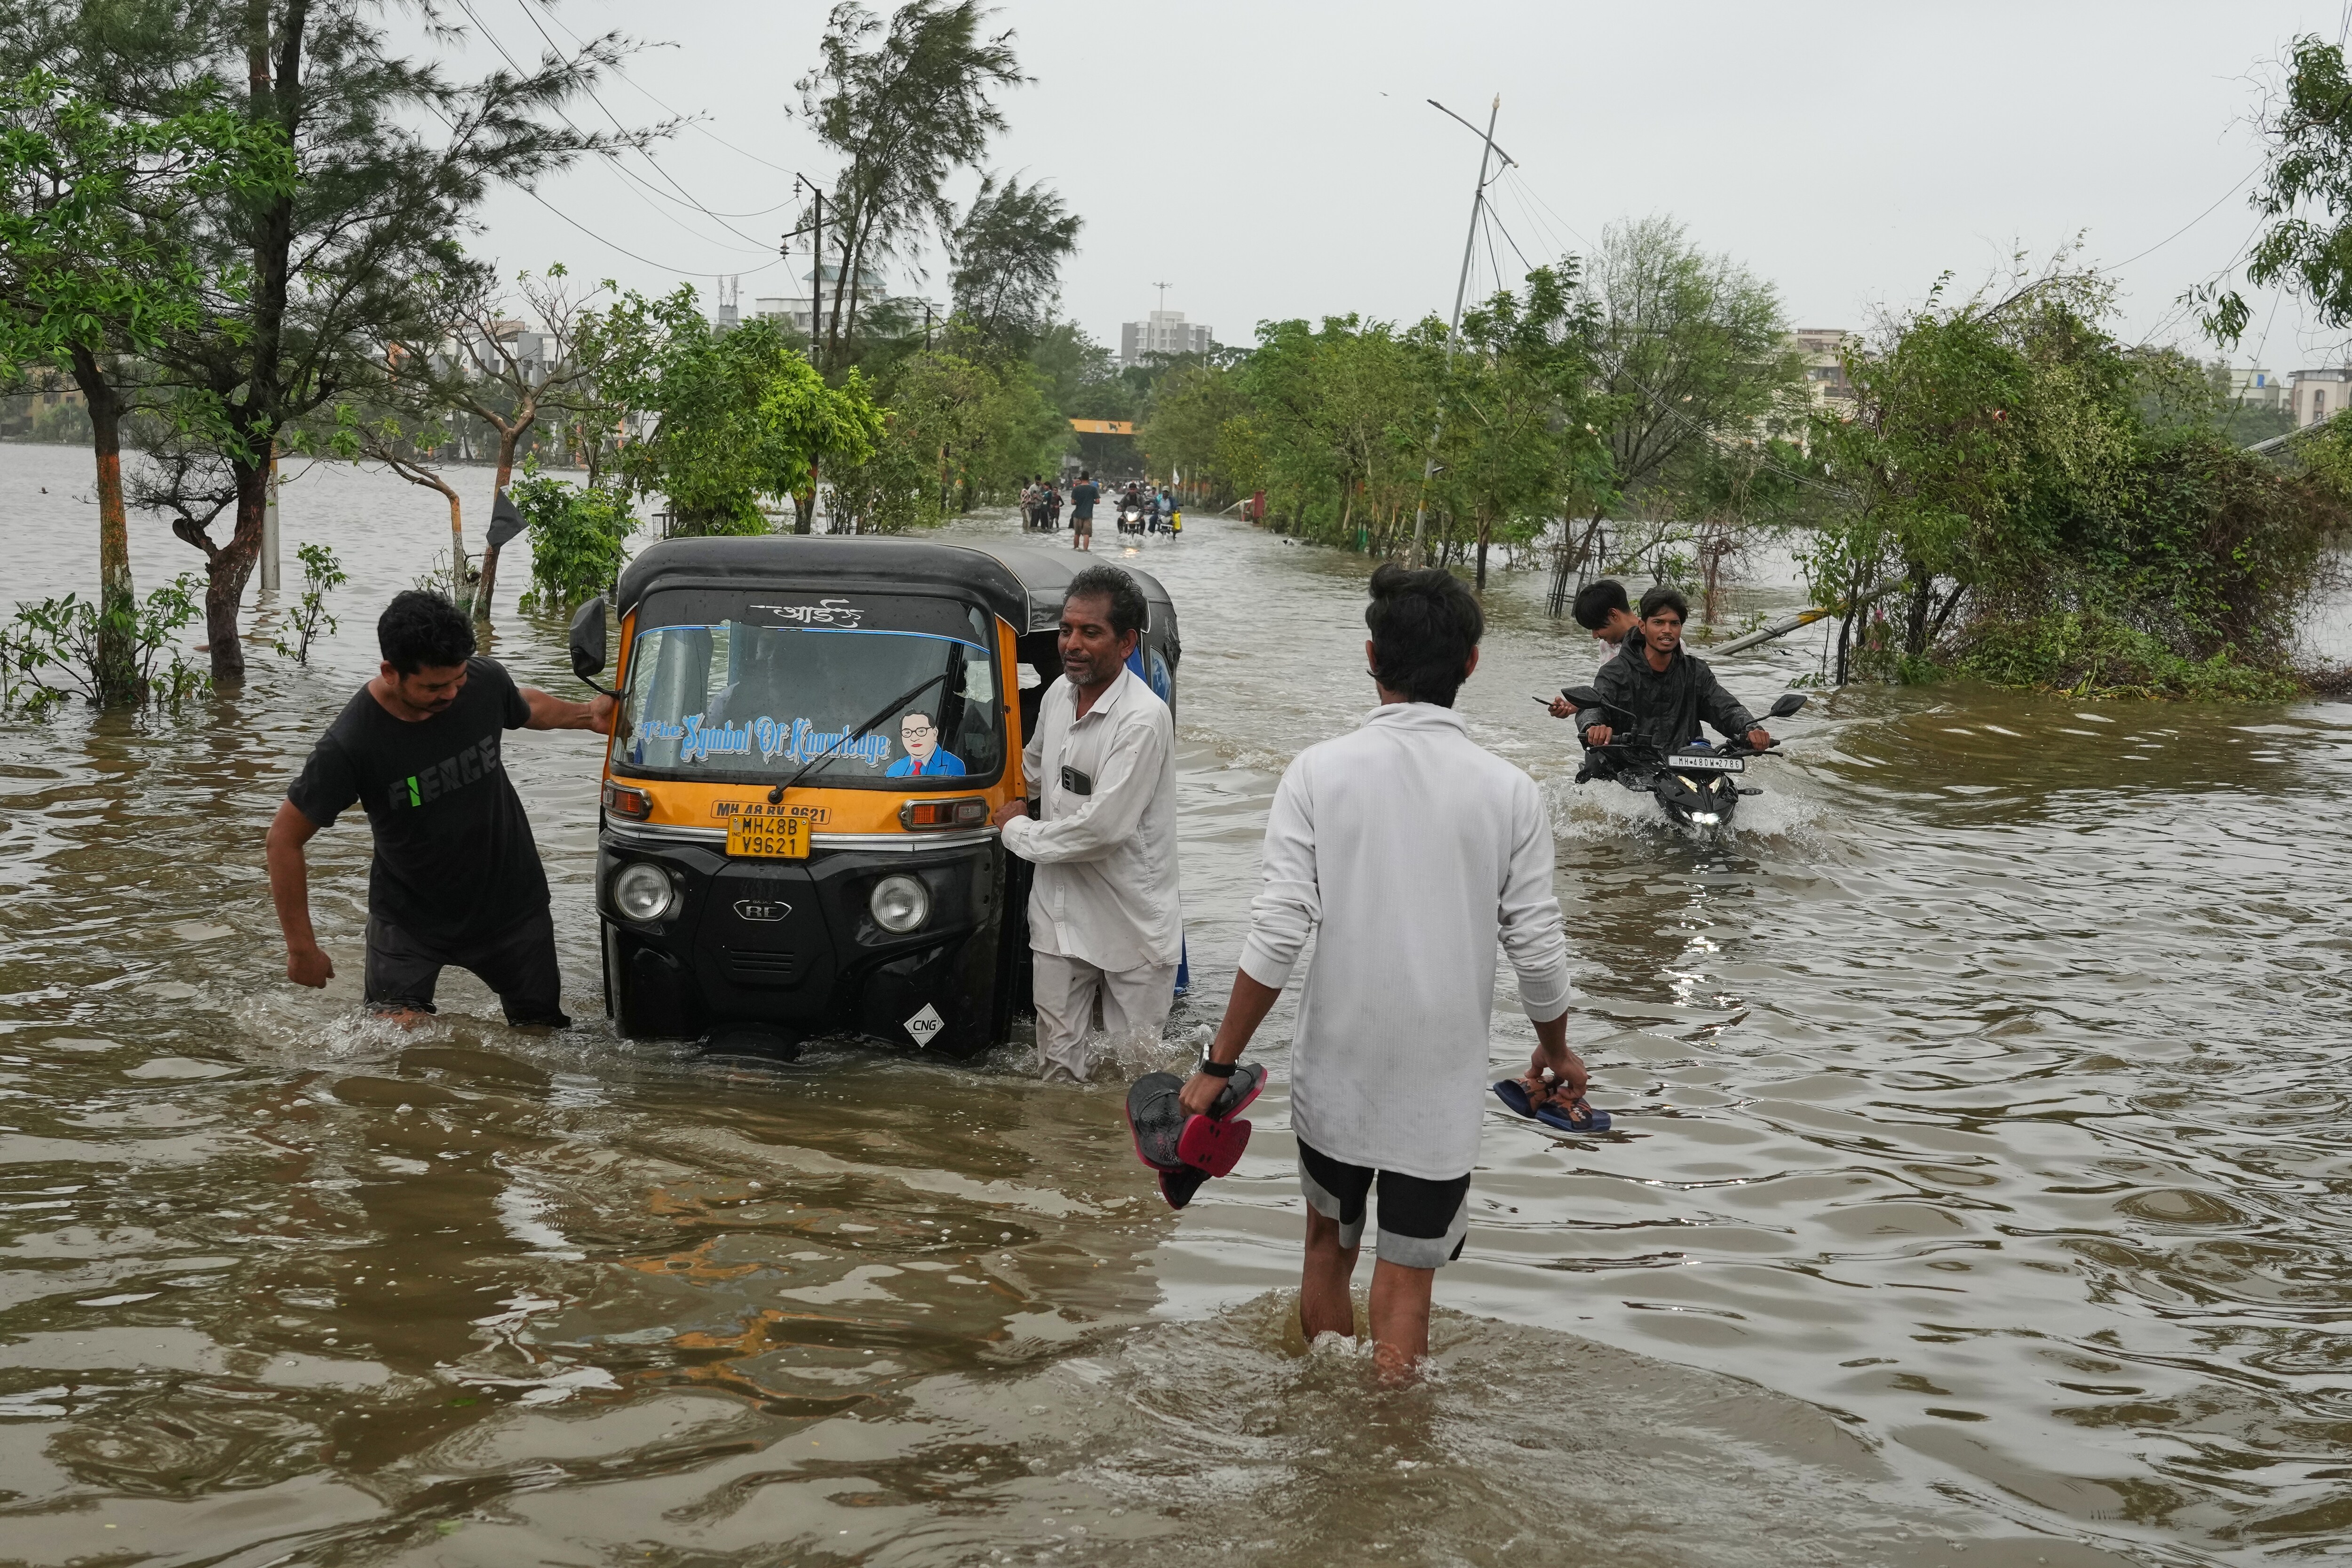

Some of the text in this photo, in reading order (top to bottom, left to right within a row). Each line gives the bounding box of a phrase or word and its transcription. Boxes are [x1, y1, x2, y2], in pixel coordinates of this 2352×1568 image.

[636, 712, 891, 768] The Symbol Of Knowledge
[716, 803, 739, 816] MH
[791, 807, 826, 822] 9621
[742, 817, 797, 835] MH48B
[743, 836, 795, 855] V9621
[746, 906, 778, 918] RE
[913, 1020, 937, 1031] CNG
